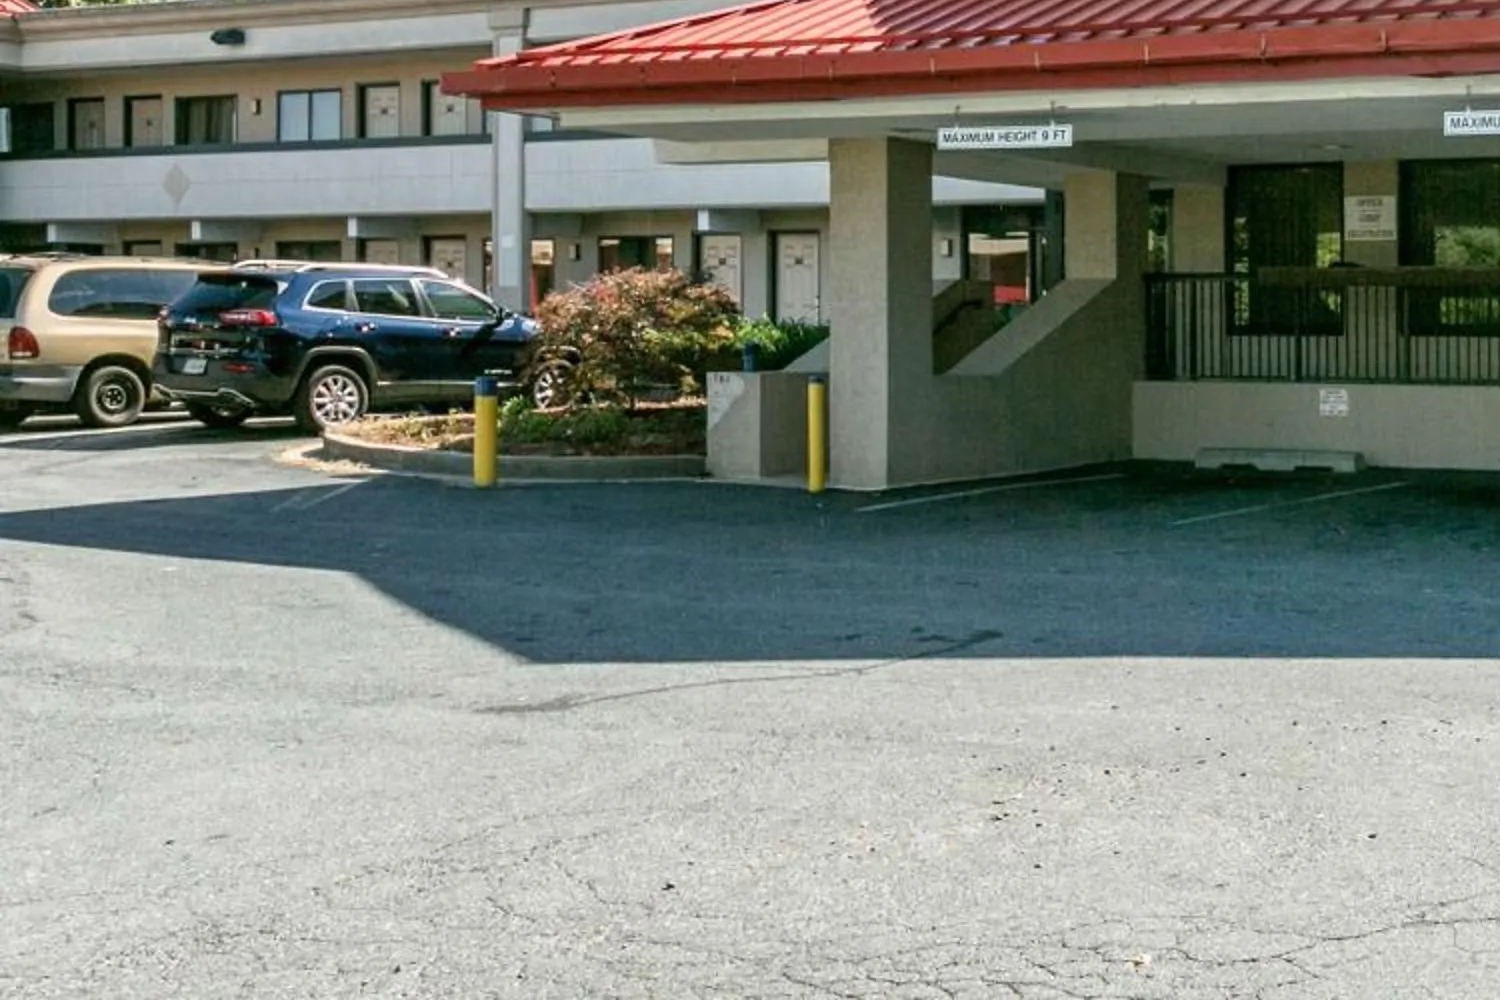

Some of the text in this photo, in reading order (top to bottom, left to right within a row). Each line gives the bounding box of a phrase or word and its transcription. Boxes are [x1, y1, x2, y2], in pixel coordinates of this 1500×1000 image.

[942, 129, 1067, 143] MAXIMUM HEIGHT 9 FT
